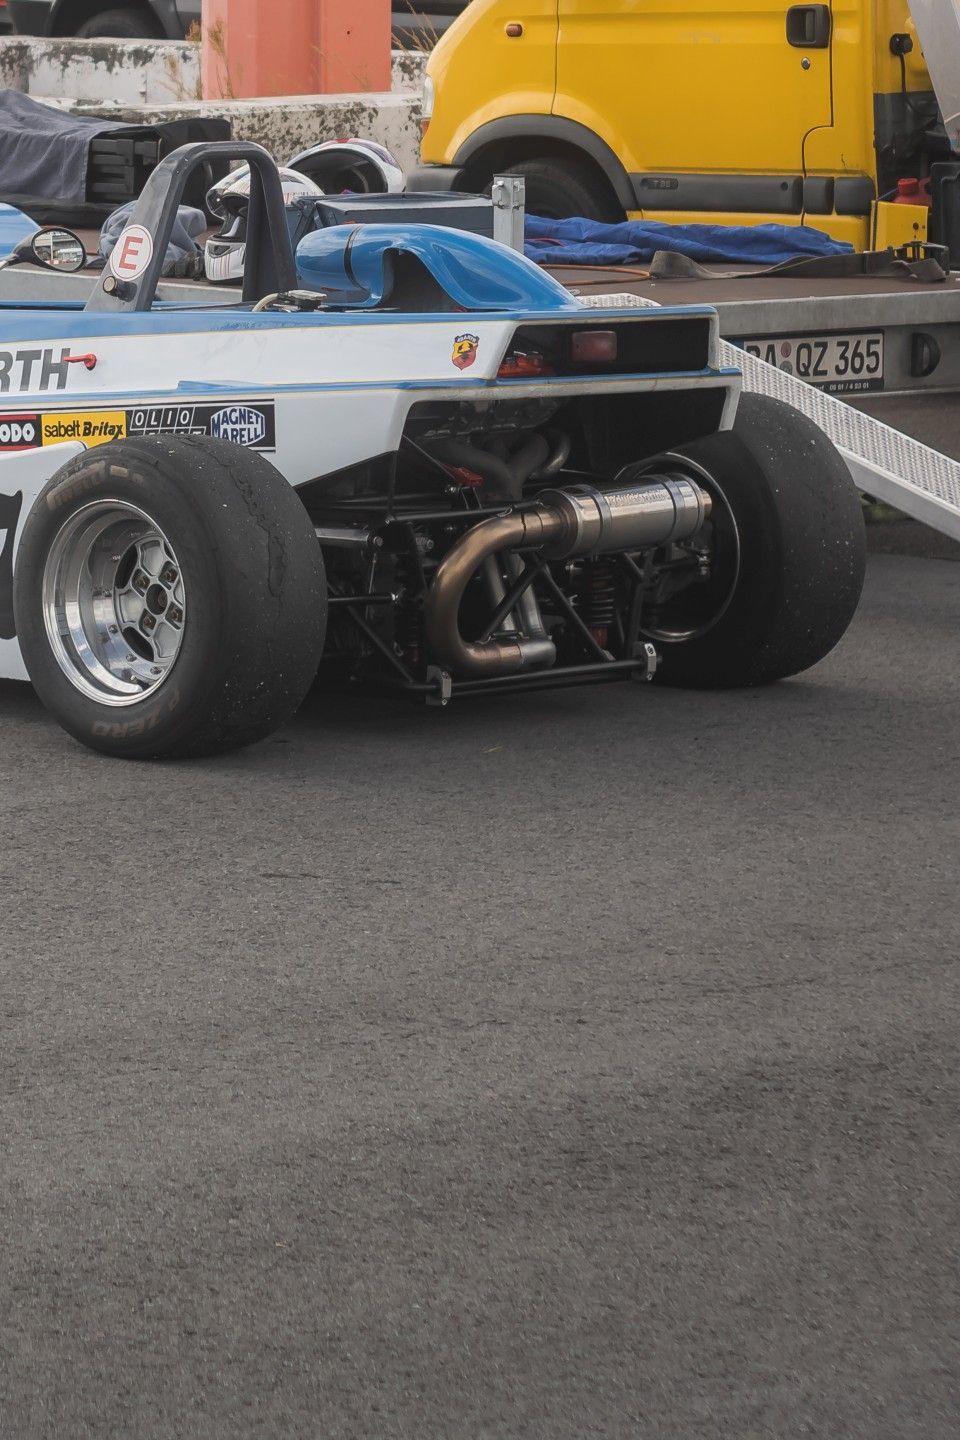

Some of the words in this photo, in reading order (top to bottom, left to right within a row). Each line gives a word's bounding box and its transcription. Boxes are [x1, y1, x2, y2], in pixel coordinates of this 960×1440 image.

[119, 236, 143, 270] E
[796, 342, 828, 376] QZ
[835, 339, 880, 375] 365
[134, 410, 190, 426] OLIO
[211, 408, 264, 428] MAGNETI
[44, 419, 80, 438] sabelt
[82, 421, 124, 441] Britax
[211, 426, 264, 446] MARELLI
